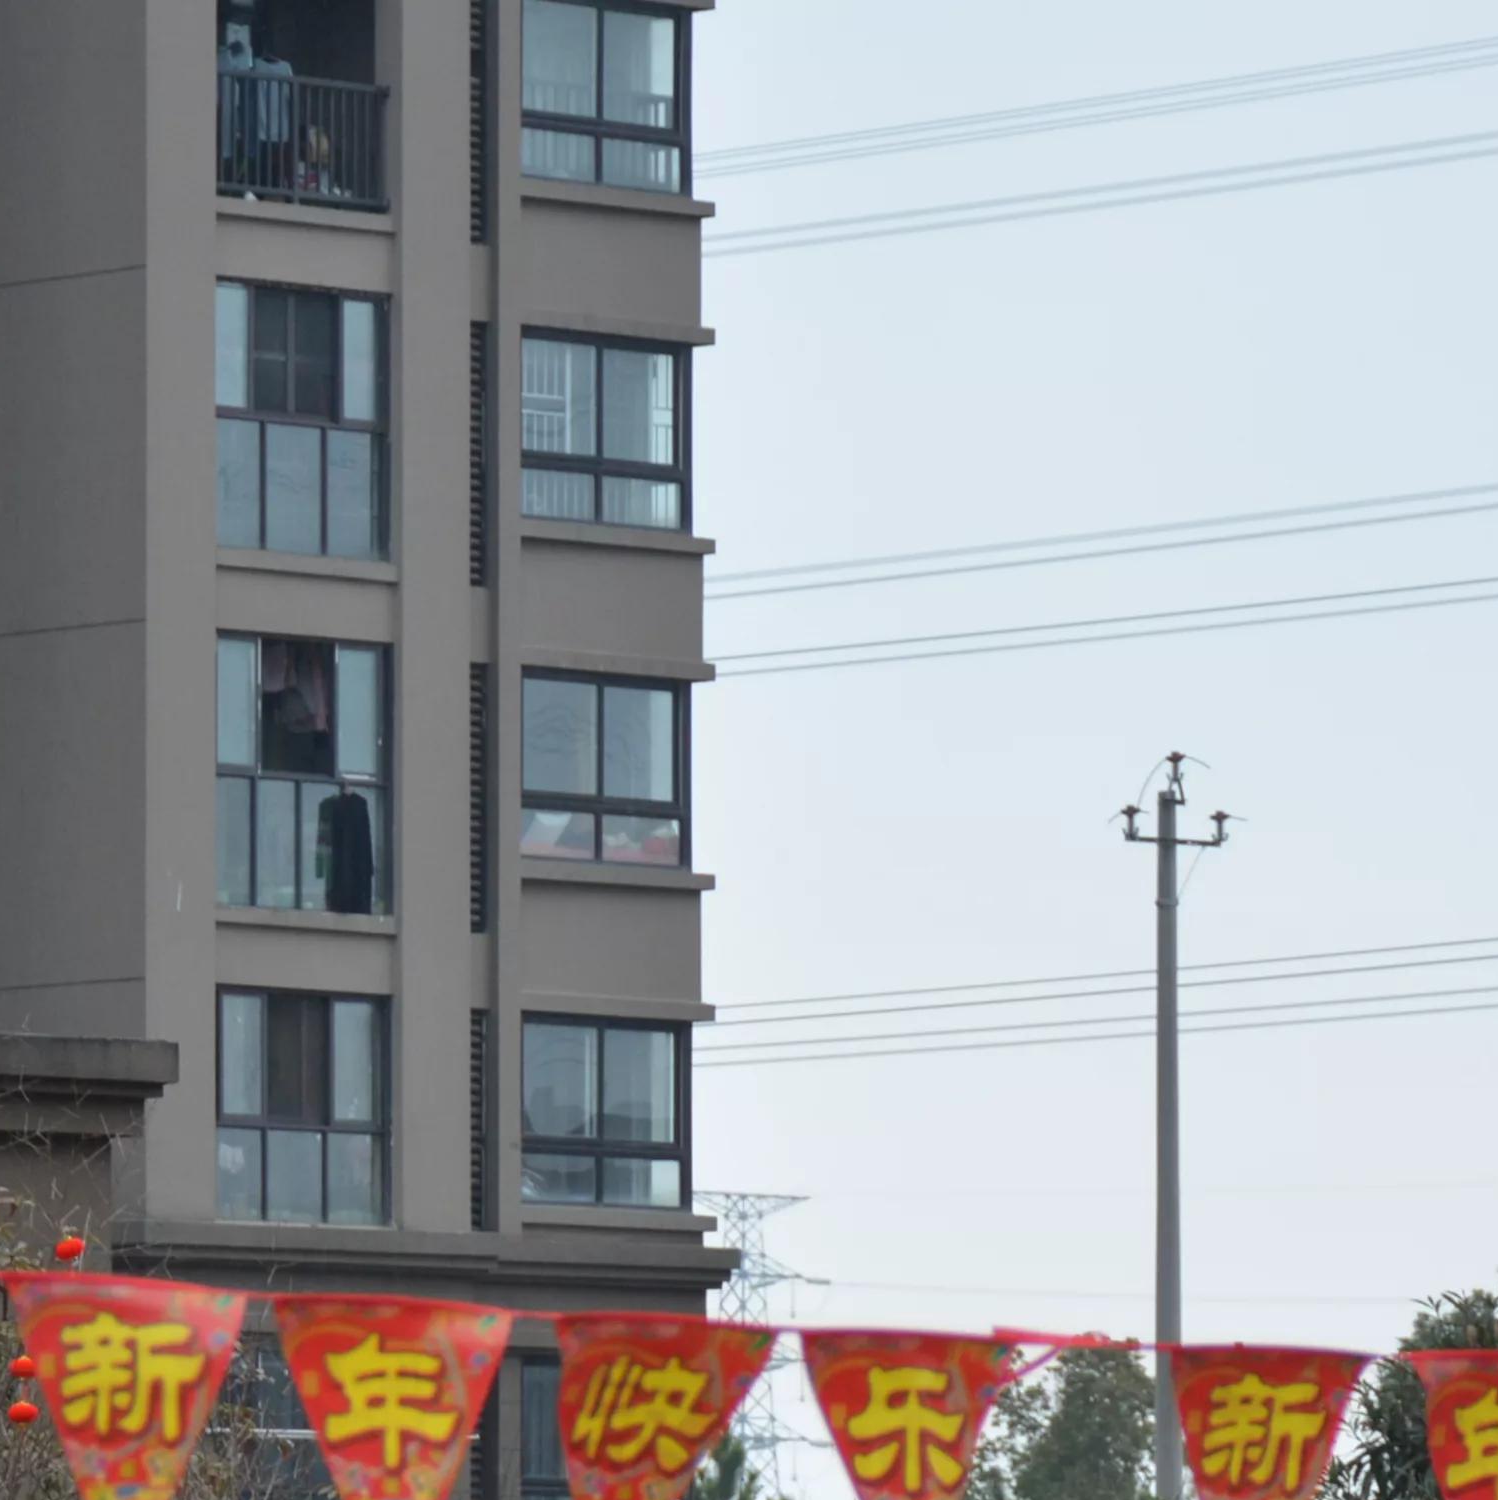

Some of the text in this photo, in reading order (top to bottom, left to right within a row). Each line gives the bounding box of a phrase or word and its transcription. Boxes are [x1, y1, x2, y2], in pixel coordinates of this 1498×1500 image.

[61, 1313, 203, 1442] 新
[325, 1333, 458, 1468] 年
[572, 1356, 716, 1472] 快
[847, 1366, 965, 1493] 乐
[1201, 1373, 1326, 1490] 新
